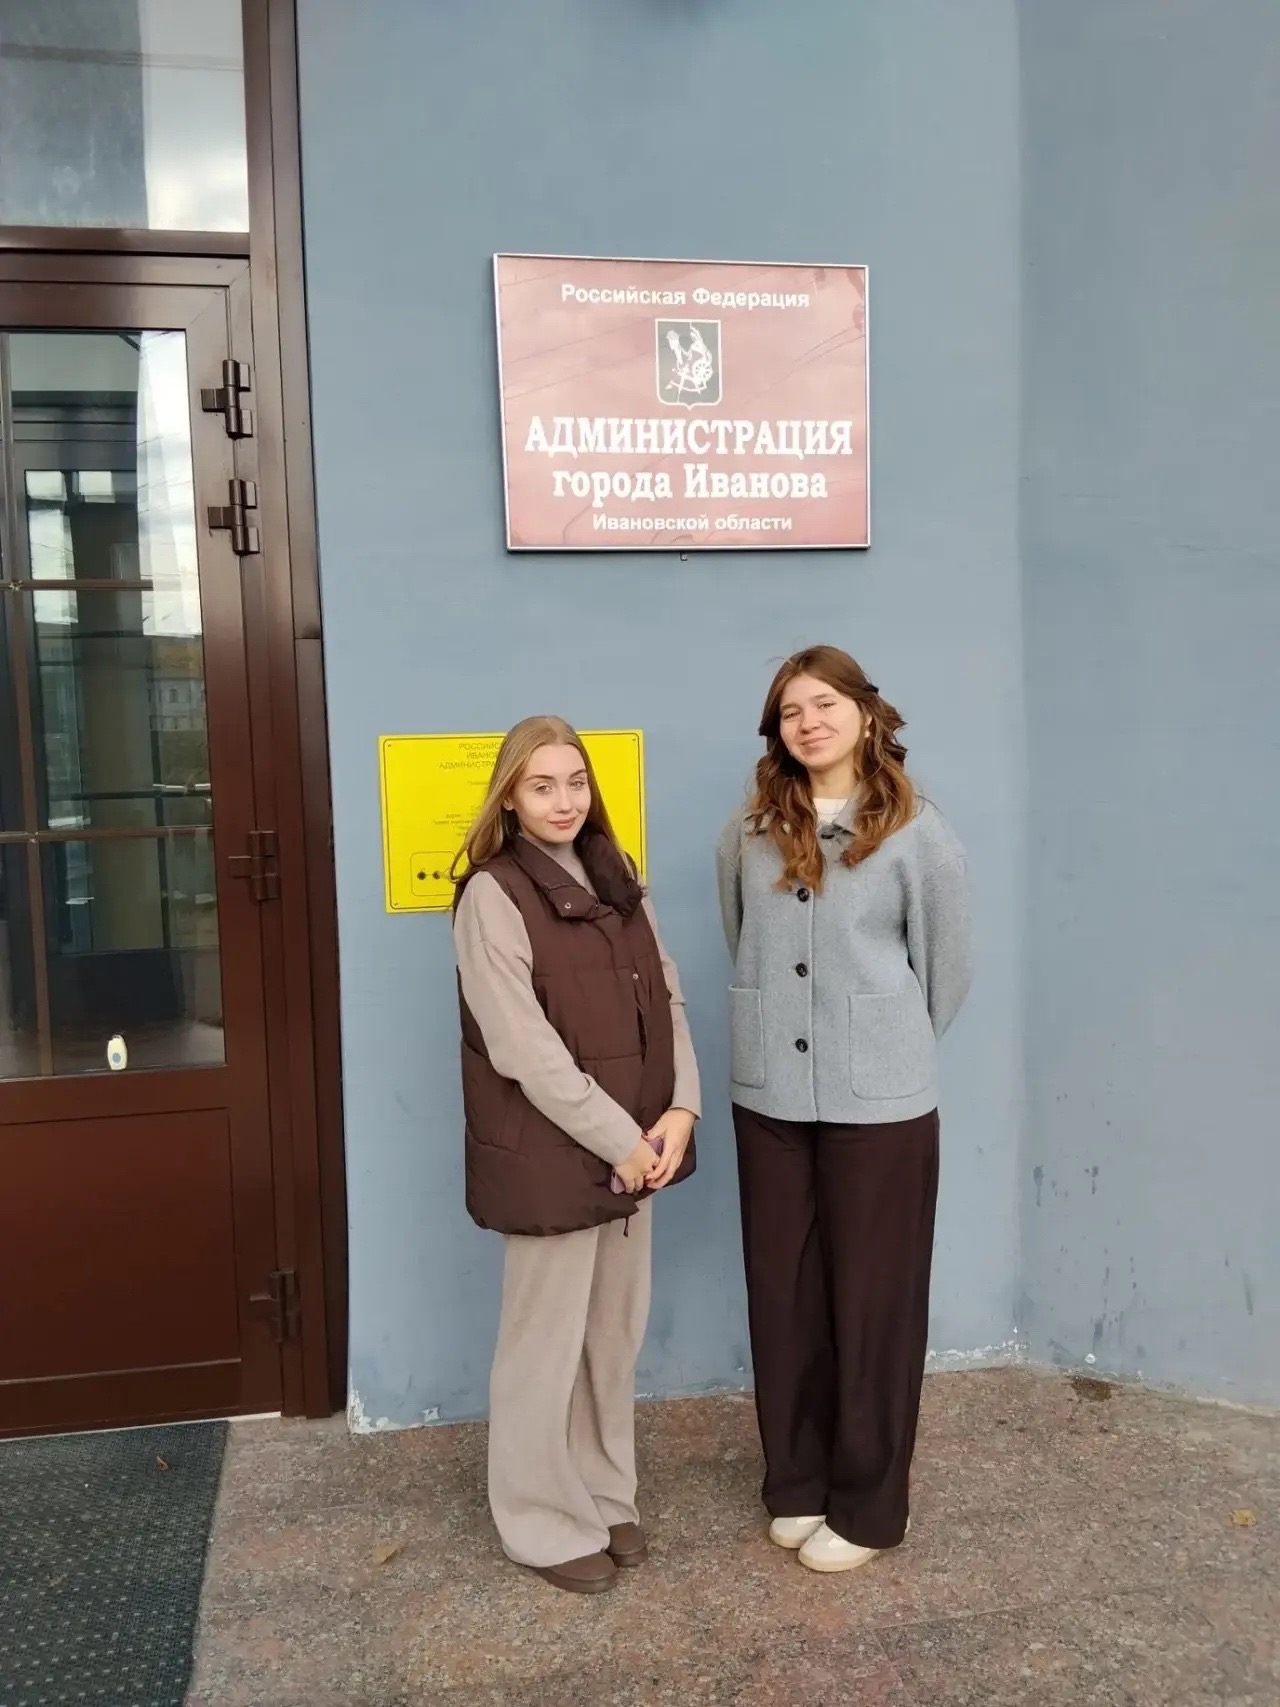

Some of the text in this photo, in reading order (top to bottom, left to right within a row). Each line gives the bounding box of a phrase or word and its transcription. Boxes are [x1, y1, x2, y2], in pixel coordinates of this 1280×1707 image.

[561, 283, 810, 310] Российская Федерация
[524, 415, 853, 460] АДМИНИСТРАЦИЯ
[552, 463, 828, 508] города Иванова
[592, 513, 793, 530] Ивановской области
